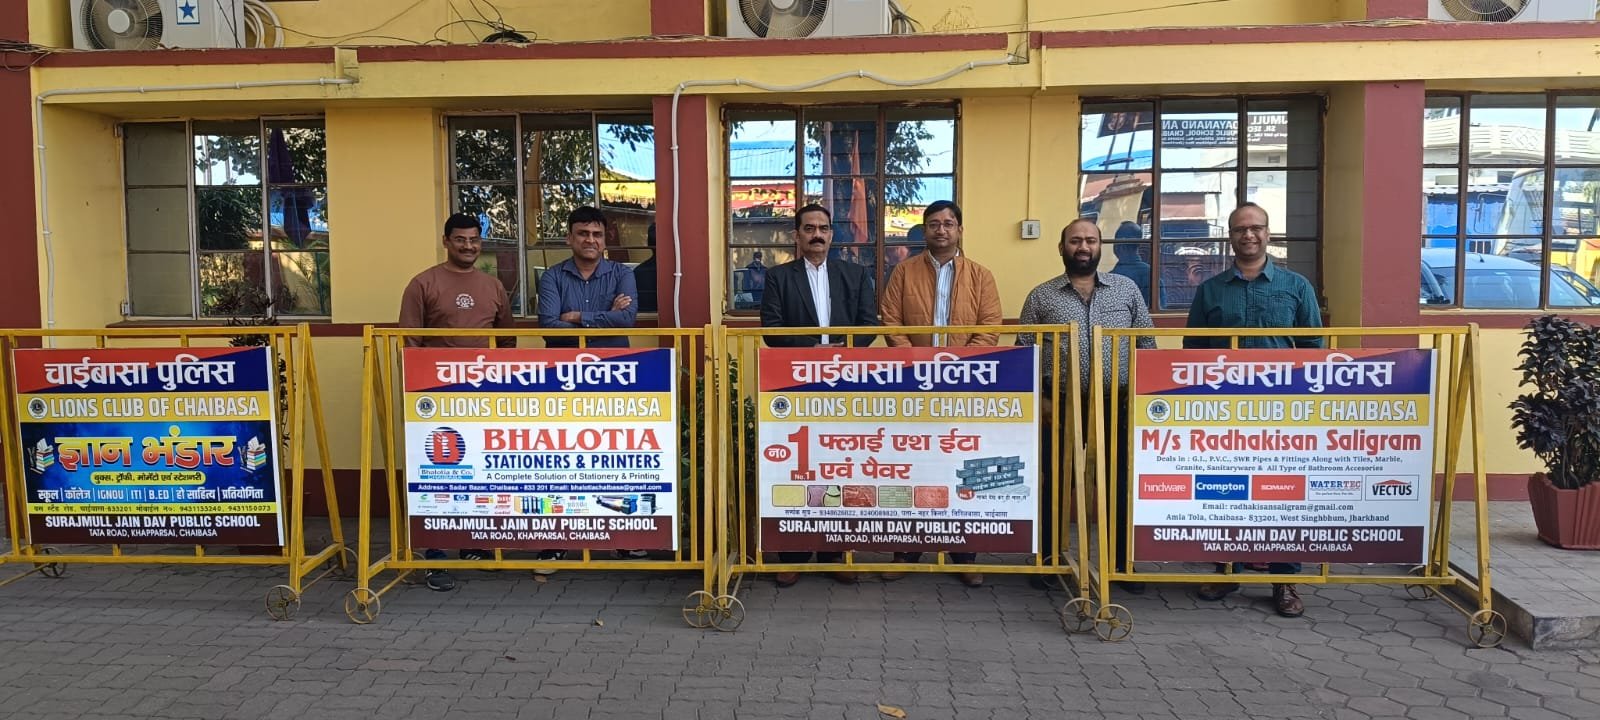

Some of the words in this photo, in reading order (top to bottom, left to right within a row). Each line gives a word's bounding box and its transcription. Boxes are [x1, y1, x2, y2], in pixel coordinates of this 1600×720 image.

[44, 357, 149, 388] चाईबासा
[155, 353, 236, 390] पुलिस
[435, 354, 548, 388] चाईबासा
[555, 353, 638, 390] पुलिस
[791, 353, 905, 388] चाईबासा
[912, 351, 999, 390] पुलिस
[1171, 354, 1296, 389] चाईबासा
[1302, 352, 1396, 392] पुलिस
[51, 397, 99, 418] LIONS
[102, 397, 144, 417] CLUB
[148, 397, 170, 417] OF
[174, 396, 260, 416] CHAIBASA
[440, 396, 491, 417] LIONS
[496, 396, 540, 417] CLUB
[545, 397, 567, 417] OF
[572, 396, 661, 417] CHAIBASA
[794, 397, 847, 418] LIONS
[852, 397, 897, 417] CLUB
[902, 397, 924, 417] OF
[929, 397, 1023, 418] CHAIBASA
[1174, 400, 1231, 421] LIONS
[1236, 400, 1285, 421] CLUB
[1290, 400, 1315, 421] OF
[1320, 400, 1418, 421] CHAIBASA
[483, 428, 662, 451] BHALOTIA
[818, 427, 885, 453] फ्लाई
[892, 434, 930, 451] एश
[938, 428, 981, 453] ईटा
[1141, 429, 1182, 455] M/s
[1190, 429, 1318, 453] Radhakisan
[1326, 429, 1422, 456] Saligram
[54, 436, 134, 471] ज्ञान
[141, 425, 237, 469] भंडार
[484, 454, 571, 469] STATIONERS
[576, 454, 586, 469] &
[591, 454, 661, 469] PRINTERS
[1281, 456, 1310, 464] Fittings
[1312, 456, 1332, 464] Along
[818, 457, 853, 479] एवं
[861, 456, 912, 479] पैवर
[1175, 464, 1205, 472] Granite,
[497, 472, 532, 481] Complete
[534, 472, 567, 481] Solution
[569, 472, 577, 480] of
[579, 472, 619, 481] Stationery
[629, 472, 660, 481] Printing
[64, 486, 91, 500] कॉलेज
[176, 487, 185, 500] हो
[186, 486, 216, 500] साहित्य
[221, 486, 264, 499] प्रतियोगिता
[1144, 482, 1186, 492] hindware
[1196, 482, 1245, 492] Crompton
[1372, 485, 1412, 496] VECTUS
[37, 489, 59, 503] स्कूल
[97, 489, 124, 500] IGNOU
[131, 489, 142, 500] ITI
[148, 489, 169, 500] B.ED
[1229, 503, 1354, 512] radhakisansaligram@gmail.com
[45, 515, 112, 528] SURAJMULL
[115, 515, 141, 528] JAIN
[144, 515, 167, 527] DAV
[170, 515, 212, 527] PUBLIC
[215, 515, 260, 527] SCHOOL
[424, 518, 497, 530] SURAJMULL
[500, 518, 528, 530] JAIN
[532, 518, 557, 530] DAV
[560, 518, 605, 530] PUBLIC
[608, 518, 657, 530] SCHOOL
[1188, 513, 1207, 521] Tola,
[1248, 514, 1278, 522] 833201,
[1301, 514, 1347, 523] Singhbhum,
[1349, 515, 1390, 523] Jharkhand
[89, 529, 105, 537] TATA
[106, 529, 130, 538] ROAD,
[131, 529, 178, 538] KHAPPARSAI,
[179, 528, 218, 537] CHAIBASA
[779, 520, 852, 533] SURAJMULL
[855, 521, 883, 533] JAIN
[887, 521, 912, 533] DAV
[915, 521, 961, 534] PUBLIC
[964, 522, 1014, 534] SCHOOL
[471, 531, 488, 540] TATA
[490, 531, 516, 541] ROAD,
[517, 531, 567, 541] KHAPPARSAI,
[569, 531, 610, 540] CHAIBASA
[825, 534, 843, 543] TATA
[844, 534, 870, 543] ROAD,
[872, 535, 922, 544] KHAPPARSAI,
[924, 535, 966, 544] CHAIBASA
[1153, 528, 1232, 541] SURAJMULL
[1235, 529, 1265, 541] JAIN
[1269, 529, 1296, 541] DAV
[1300, 529, 1349, 541] PUBLIC
[1352, 529, 1404, 541] SCHOOL
[1202, 543, 1221, 552] TATA
[1223, 543, 1251, 552] ROAD,
[1253, 543, 1307, 552] KHAPPARSAI,
[1309, 543, 1353, 551] CHAIBASA
